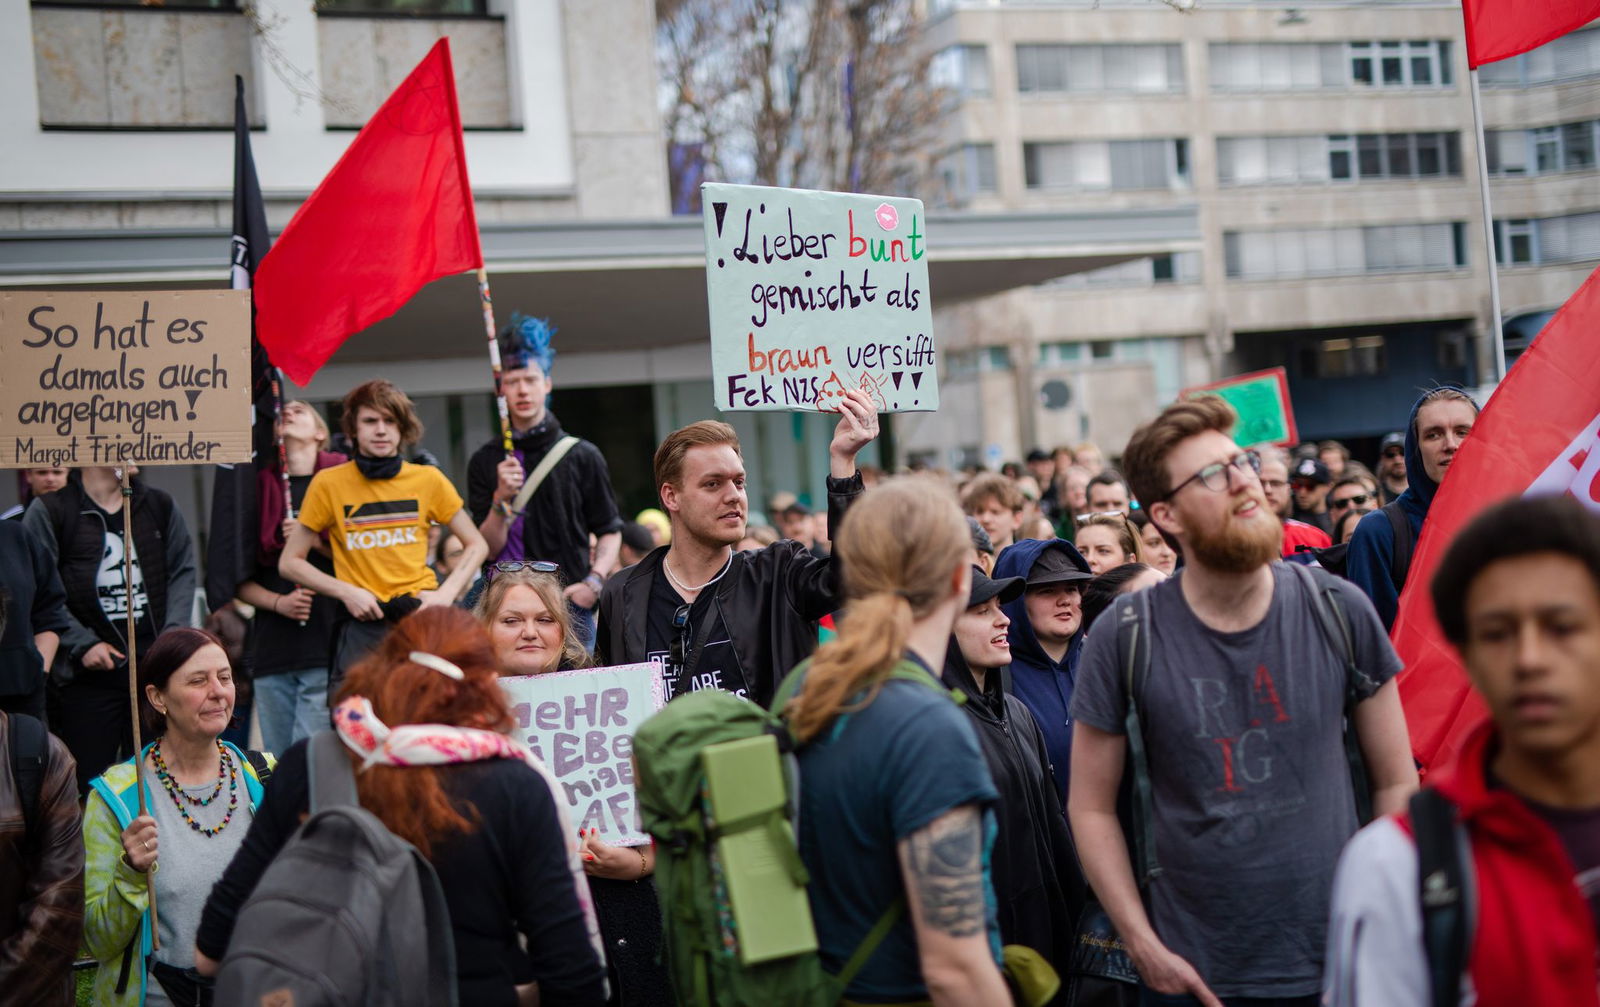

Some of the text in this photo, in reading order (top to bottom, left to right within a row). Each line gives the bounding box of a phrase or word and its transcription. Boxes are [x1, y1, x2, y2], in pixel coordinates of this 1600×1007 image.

[848, 208, 924, 262] bunt
[751, 268, 921, 327] gemischt als
[22, 300, 208, 350] So hat es
[39, 351, 228, 391] damals auch
[747, 332, 935, 376] braun versifft
[727, 374, 776, 408] Fck
[15, 431, 221, 468] Margot Friedländer
[345, 526, 418, 551] KODAK
